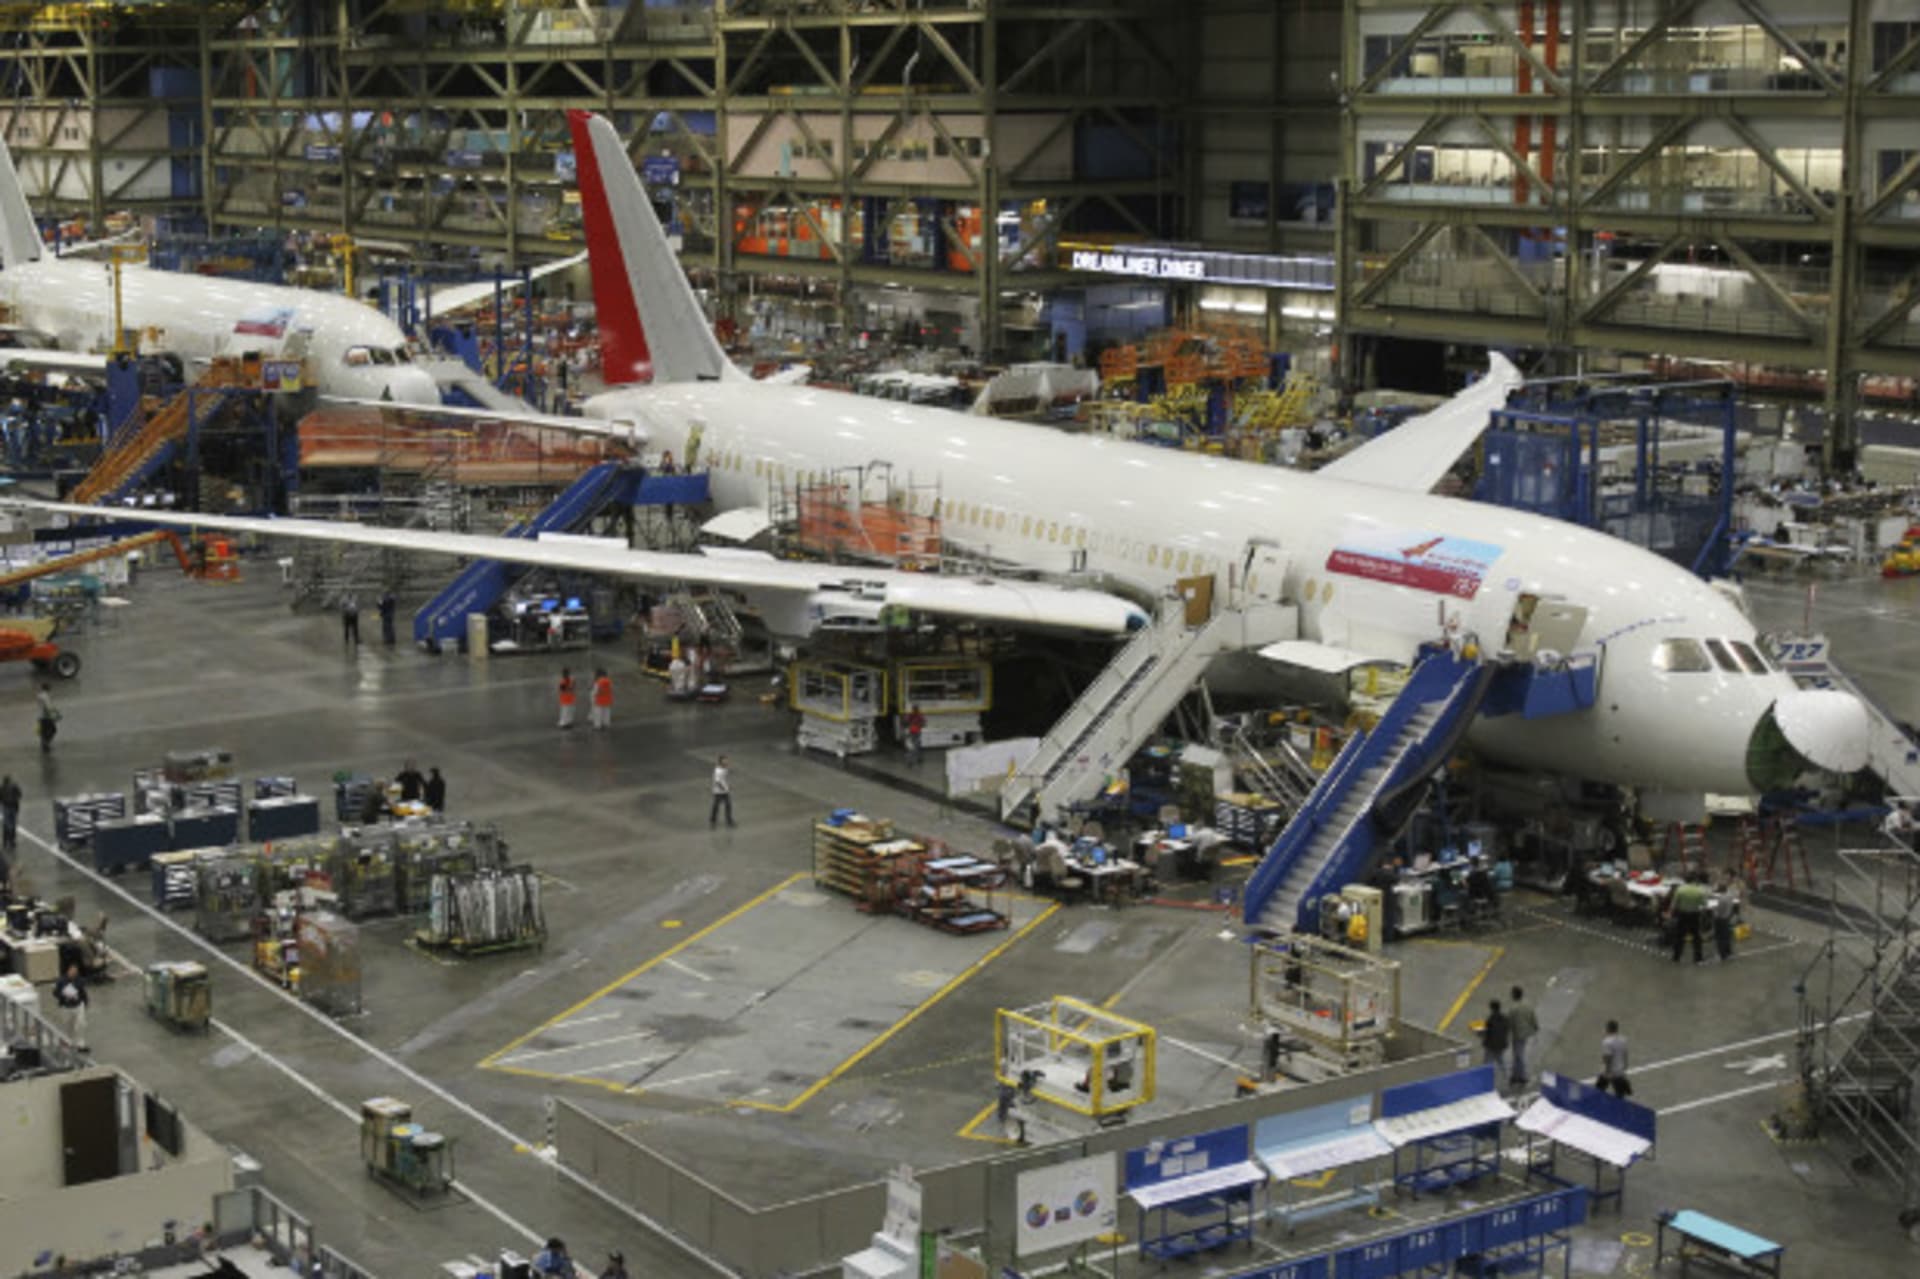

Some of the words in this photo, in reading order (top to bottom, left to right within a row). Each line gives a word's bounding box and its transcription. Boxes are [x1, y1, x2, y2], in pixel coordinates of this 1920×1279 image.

[1073, 252, 1156, 276] DREAMLINER
[1160, 257, 1205, 278] DINER
[1775, 643, 1824, 662] 787
